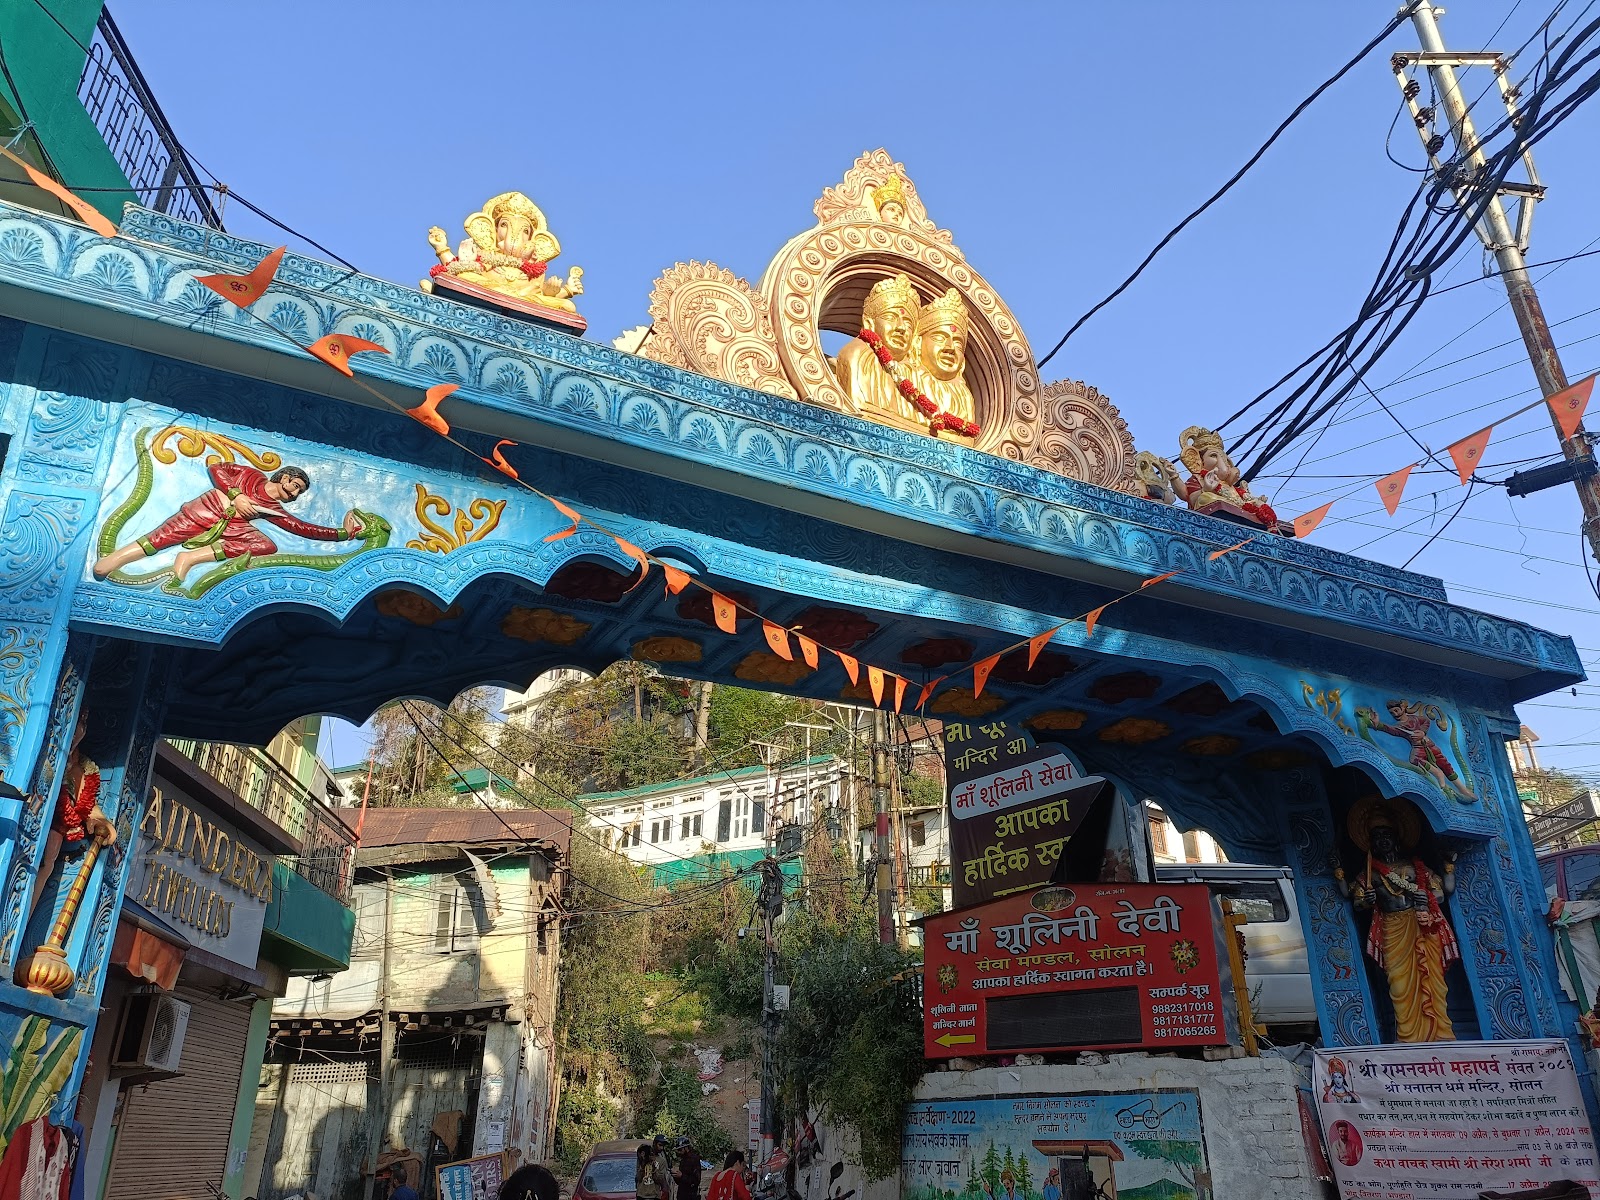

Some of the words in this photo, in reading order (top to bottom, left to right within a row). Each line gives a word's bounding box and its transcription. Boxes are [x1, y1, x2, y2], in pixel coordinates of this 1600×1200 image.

[953, 745, 998, 772] मन्दिर
[956, 783, 976, 809] माँ
[980, 768, 1034, 808] शूलिनी
[1038, 762, 1073, 787] सेवा
[1570, 801, 1585, 815] Club
[994, 798, 1070, 838] आपका
[963, 841, 1030, 887] हार्दिक
[943, 916, 981, 955] माँ
[990, 905, 1100, 955] शूलिनी
[1112, 895, 1183, 937] देवी
[975, 956, 1011, 973] सेवा
[1016, 951, 1081, 968] मण्डल,
[1087, 943, 1147, 962] सोलन
[972, 971, 1011, 990] आपका
[1013, 969, 1051, 986] हार्दिक
[1053, 967, 1095, 983] स्वागत
[1098, 965, 1134, 979] करता
[1148, 982, 1187, 998] सम्पर्क
[1188, 984, 1210, 999] सूत्र
[930, 1002, 956, 1017] शूलिनी
[959, 1003, 978, 1012] माता
[1152, 1001, 1214, 1014] 9882317018
[932, 1018, 957, 1030] मन्दिर
[958, 1016, 976, 1028] मार्ग
[1153, 1013, 1215, 1026] 9817131777
[1154, 1026, 1216, 1038] 9817065265
[1359, 1057, 1378, 1080] श्री
[1381, 1056, 1446, 1080] रामनवमी
[1449, 1054, 1501, 1078] महापर्व
[1505, 1058, 1534, 1076] संवत
[1384, 1080, 1400, 1095] श्री
[1403, 1082, 1443, 1095] सनातन
[1446, 1079, 1464, 1093] धर्म
[1509, 1077, 1543, 1092] सोलन
[1387, 1099, 1413, 1109] धूमधाम
[1414, 1097, 1421, 1107] से
[1422, 1098, 1446, 1107] मनाया
[1459, 1098, 1470, 1107] रहा
[1471, 1095, 1478, 1106] है
[1486, 1096, 1516, 1107] सपरिवार
[1518, 1095, 1536, 1105] मित्रों
[1537, 1094, 1557, 1105] सहित
[1377, 1113, 1387, 1122] कर
[1430, 1111, 1437, 1122] से
[1438, 1110, 1465, 1122] सहयोग
[1465, 1110, 1482, 1121] देकर
[1482, 1109, 1503, 1121] शोभा
[1526, 1111, 1531, 1119] व
[1550, 1109, 1567, 1118] लाभ
[1568, 1106, 1579, 1118] करें
[1388, 1127, 1407, 1139] मन्दिर
[1430, 1128, 1456, 1139] मंगलवार
[1492, 1127, 1499, 1139] से
[1501, 1128, 1521, 1142] बुधवार
[1523, 1129, 1530, 1138] 17
[1557, 1127, 1575, 1136] 2024
[1577, 1126, 1590, 1136] तक
[1532, 1143, 1541, 1151] 03
[1545, 1140, 1552, 1151] से
[1554, 1141, 1563, 1150] 06
[1565, 1139, 1579, 1151] बजे
[1581, 1140, 1593, 1150] तक
[935, 1160, 961, 1177] जवान
[1373, 1157, 1395, 1169] कथा
[1398, 1157, 1428, 1169] वाचक
[1430, 1155, 1460, 1169] स्वामी
[1463, 1155, 1479, 1170] श्री
[1481, 1155, 1505, 1169] नरेश
[1507, 1153, 1531, 1168] शर्मा
[1537, 1154, 1552, 1168] जी
[1560, 1156, 1570, 1167] के
[1575, 1157, 1594, 1168] द्वारा
[1508, 1181, 1515, 1189] 17
